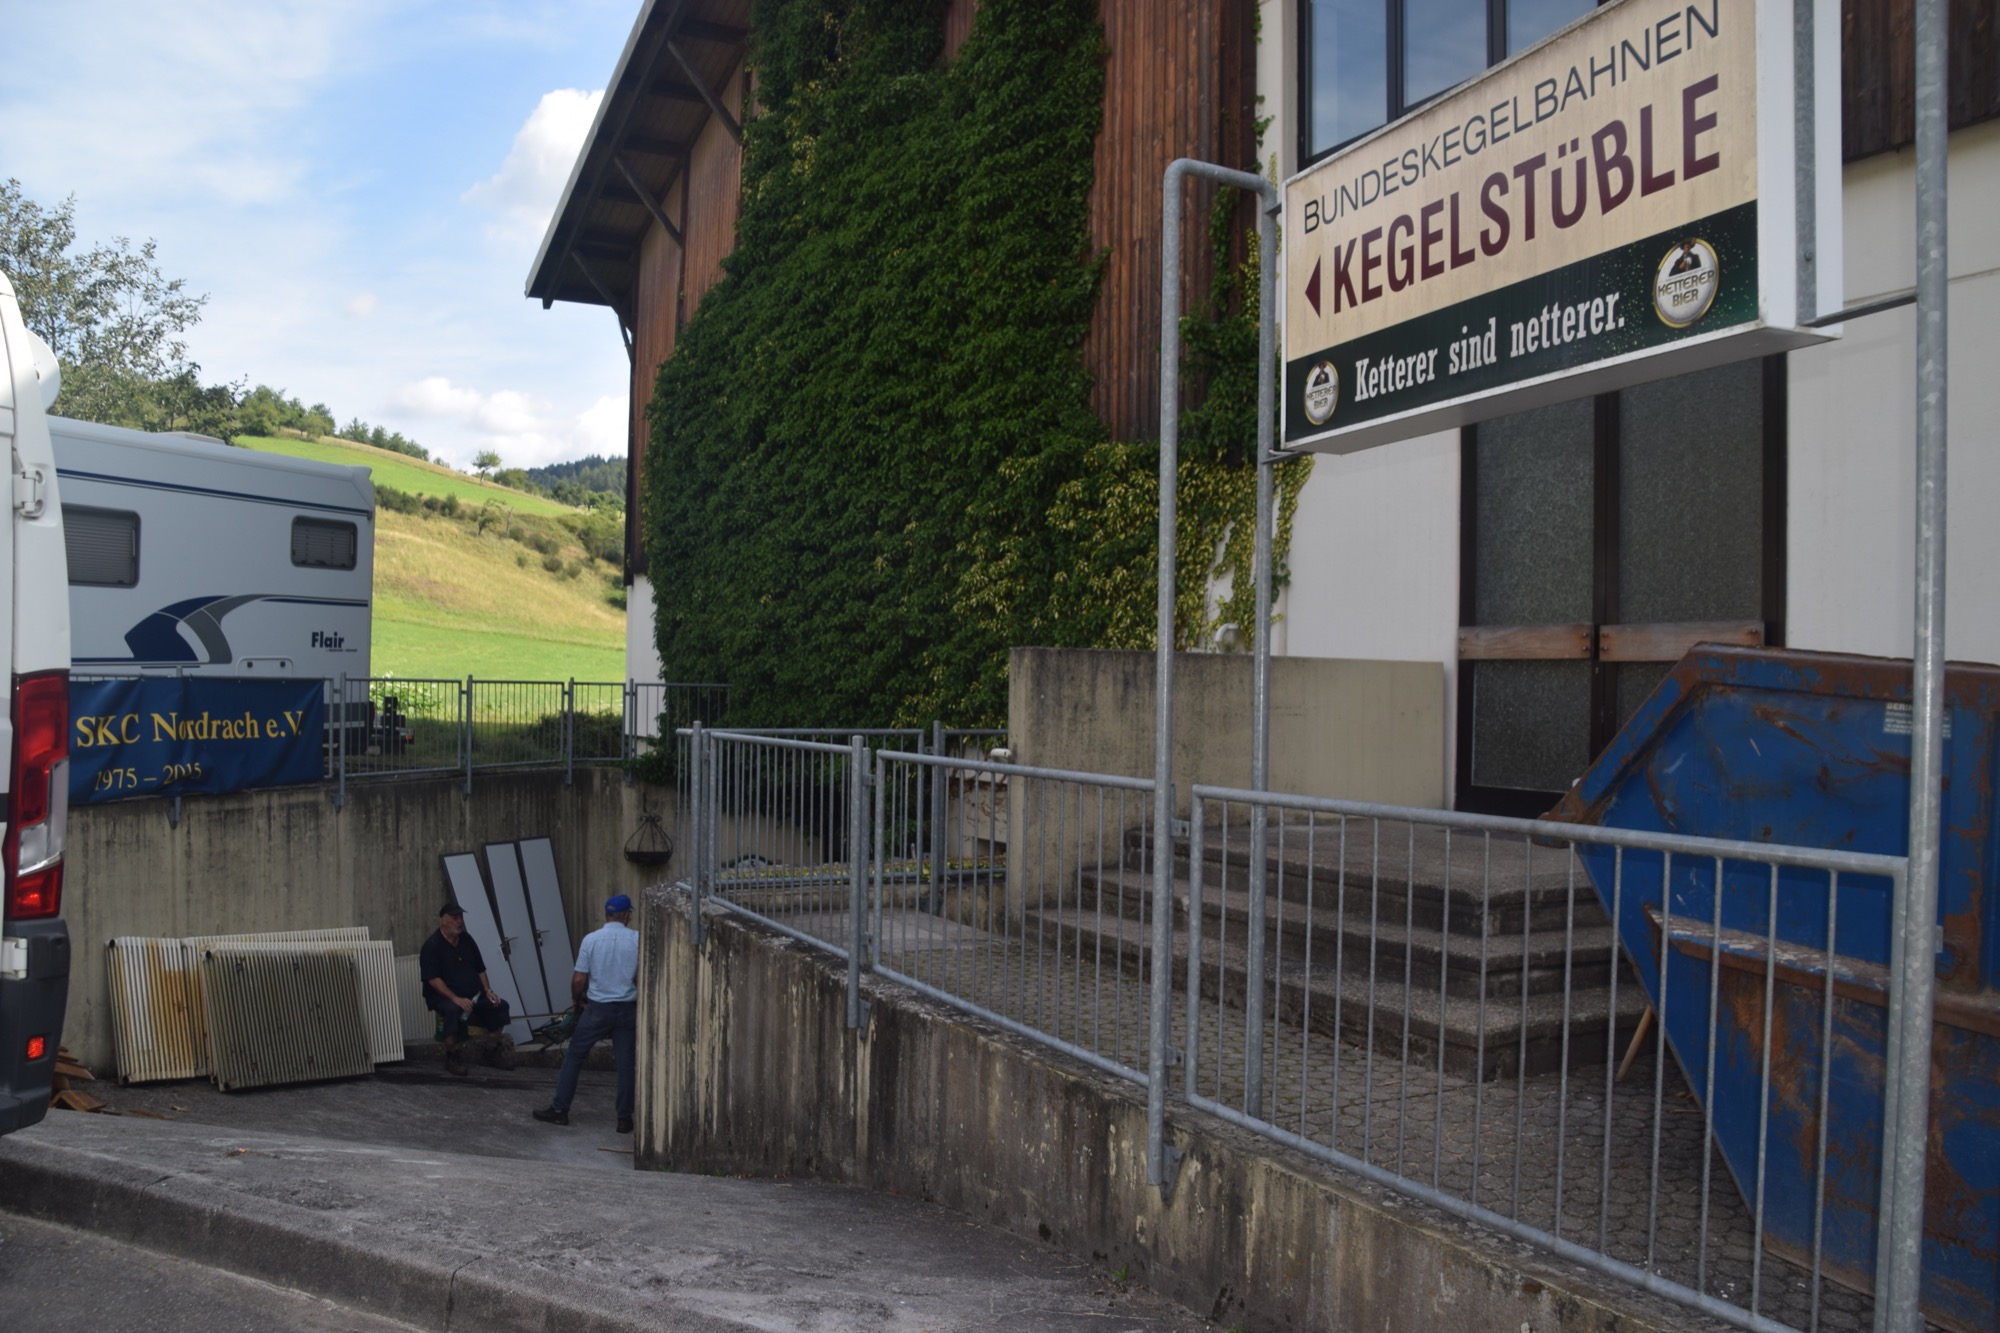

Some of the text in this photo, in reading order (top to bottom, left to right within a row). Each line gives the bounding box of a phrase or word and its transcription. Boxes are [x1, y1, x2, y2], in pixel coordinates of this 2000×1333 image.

[1304, 0, 1719, 235] BUNDESKEGELBAHNEN
[1333, 73, 1720, 314] KEGELSTÜBLE
[1657, 269, 1715, 298] KETTERER
[1672, 288, 1699, 308] BIER
[1354, 291, 1625, 402] Ketterer sind netterer.
[311, 630, 345, 649] Flair
[76, 713, 141, 748] SKC
[151, 710, 260, 743] Nordrach
[95, 767, 138, 791] 1975
